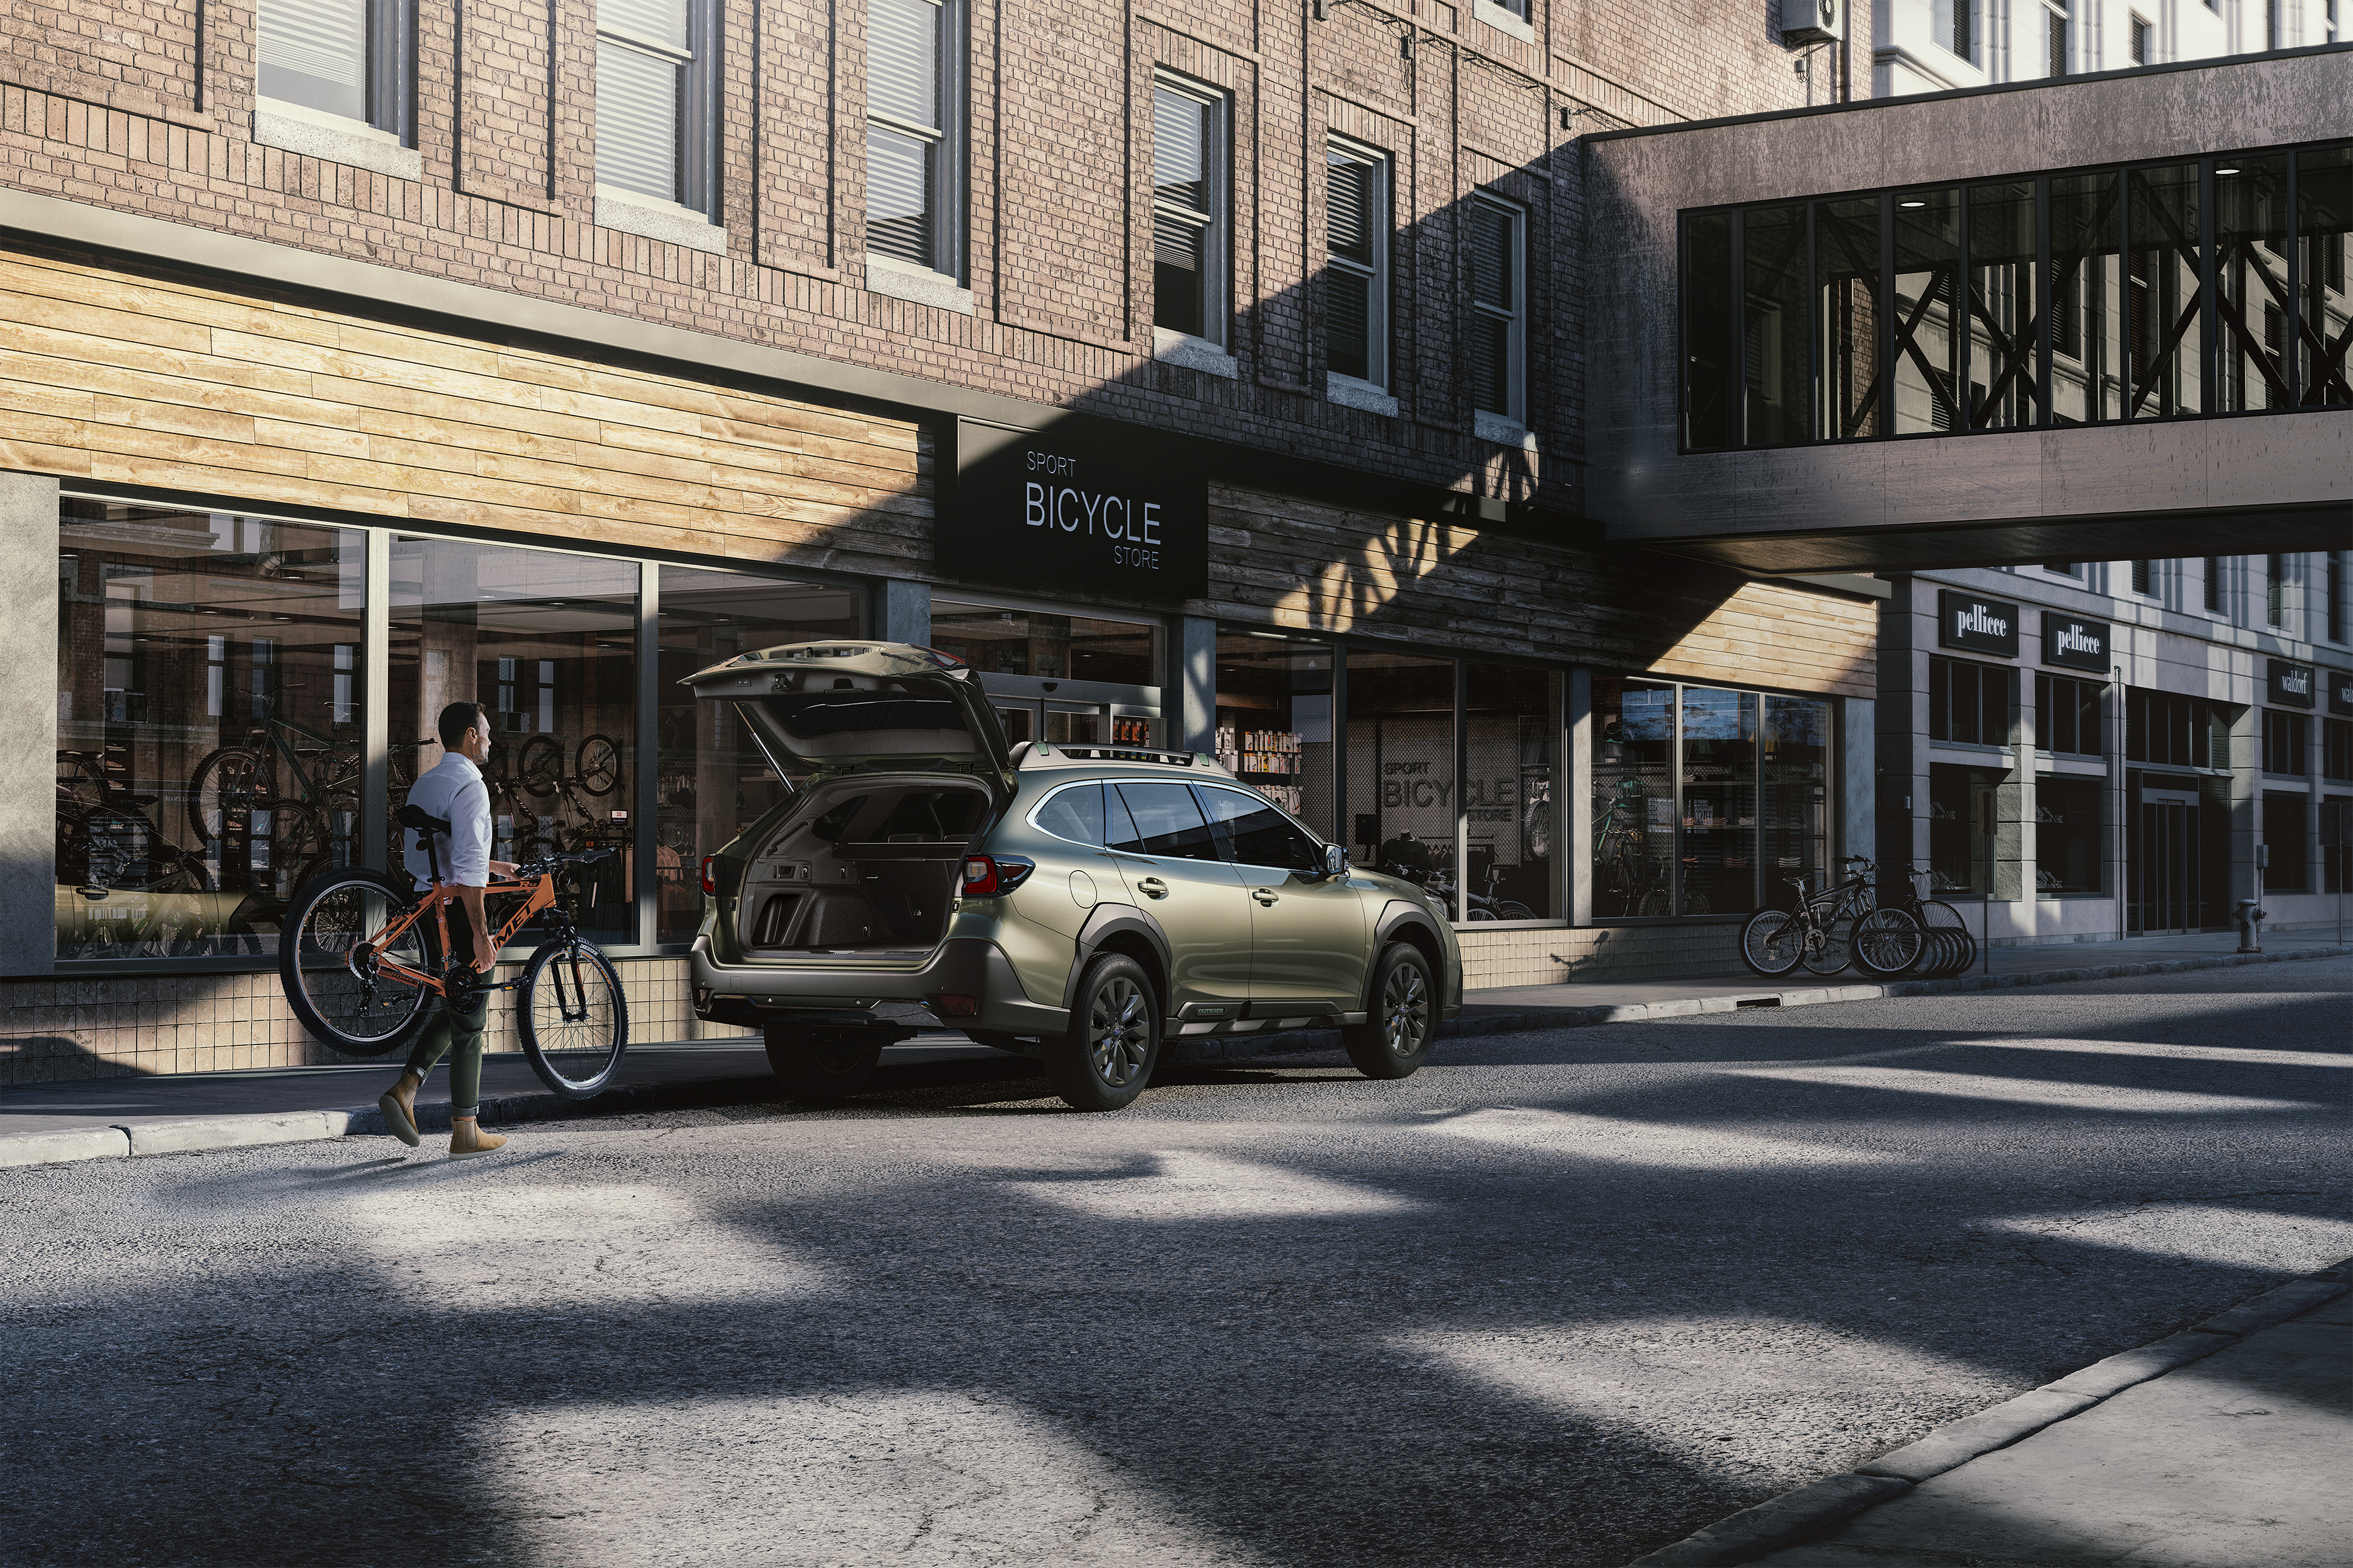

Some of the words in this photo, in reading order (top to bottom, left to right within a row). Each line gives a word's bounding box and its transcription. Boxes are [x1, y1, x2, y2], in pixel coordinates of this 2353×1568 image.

[1027, 451, 1076, 477] SPORT
[1026, 482, 1161, 545] BICYCLE
[1114, 546, 1159, 569] STORE
[1957, 604, 2007, 638] pellicce
[2057, 624, 2100, 655] pellicce
[2282, 670, 2307, 694] waldorf
[1385, 762, 1430, 774] SPORT
[1467, 809, 1512, 821] STORE
[83, 822, 110, 837] NAVIGATOR
[1830, 893, 1855, 924] STELS
[580, 944, 599, 956] DEESTONE
